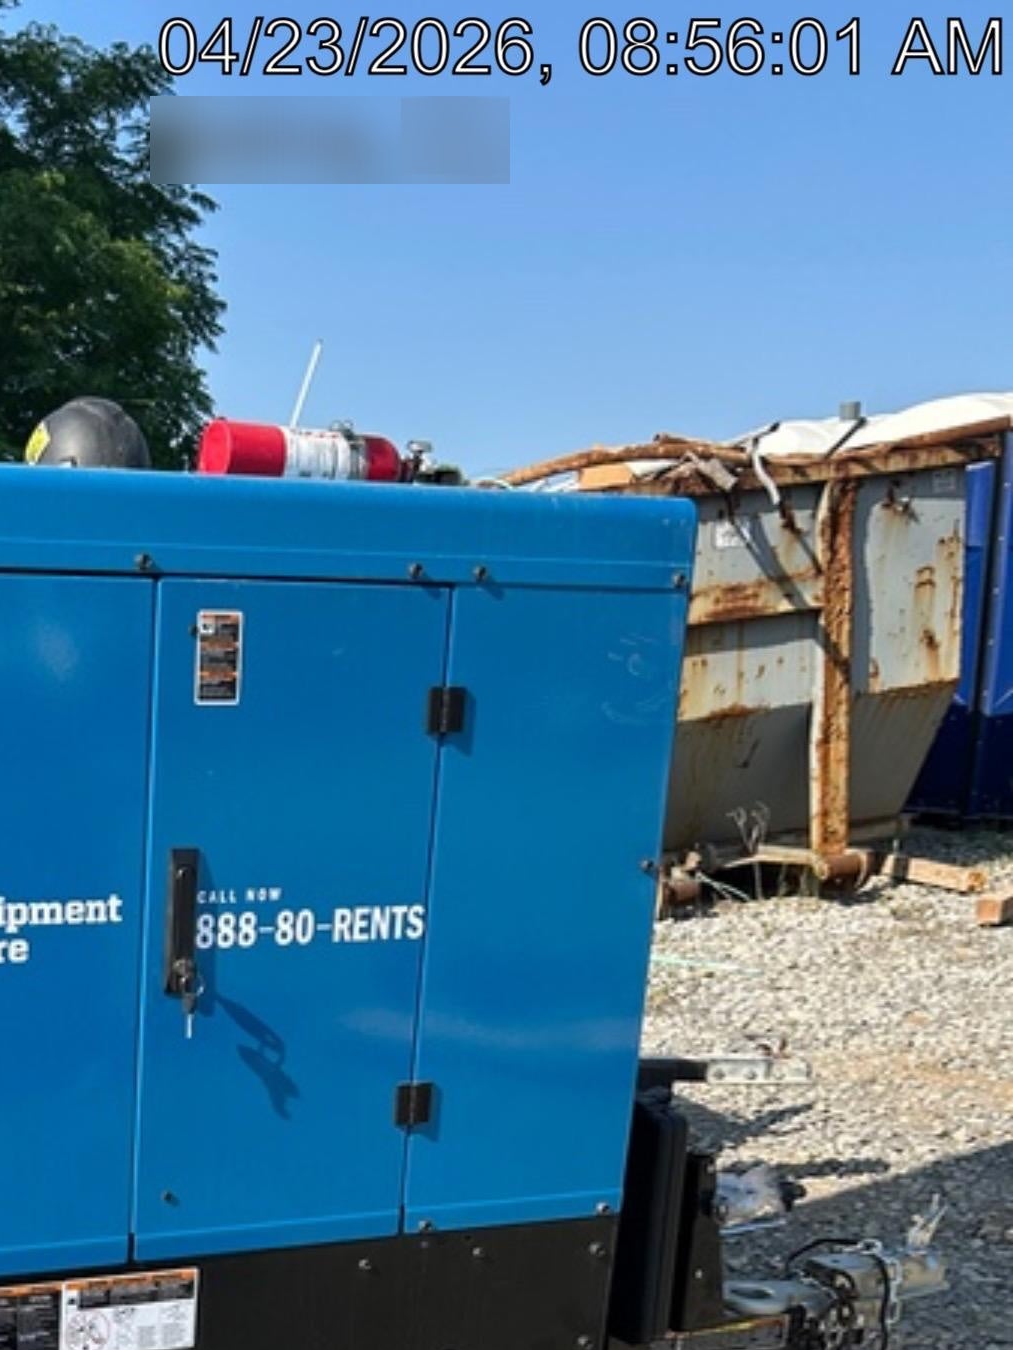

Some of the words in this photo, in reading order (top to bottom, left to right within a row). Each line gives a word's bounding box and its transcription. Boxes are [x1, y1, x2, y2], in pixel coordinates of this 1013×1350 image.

[196, 889, 238, 905] CALL
[244, 887, 282, 902] NOW
[195, 904, 427, 950] 888-80-RENTS
